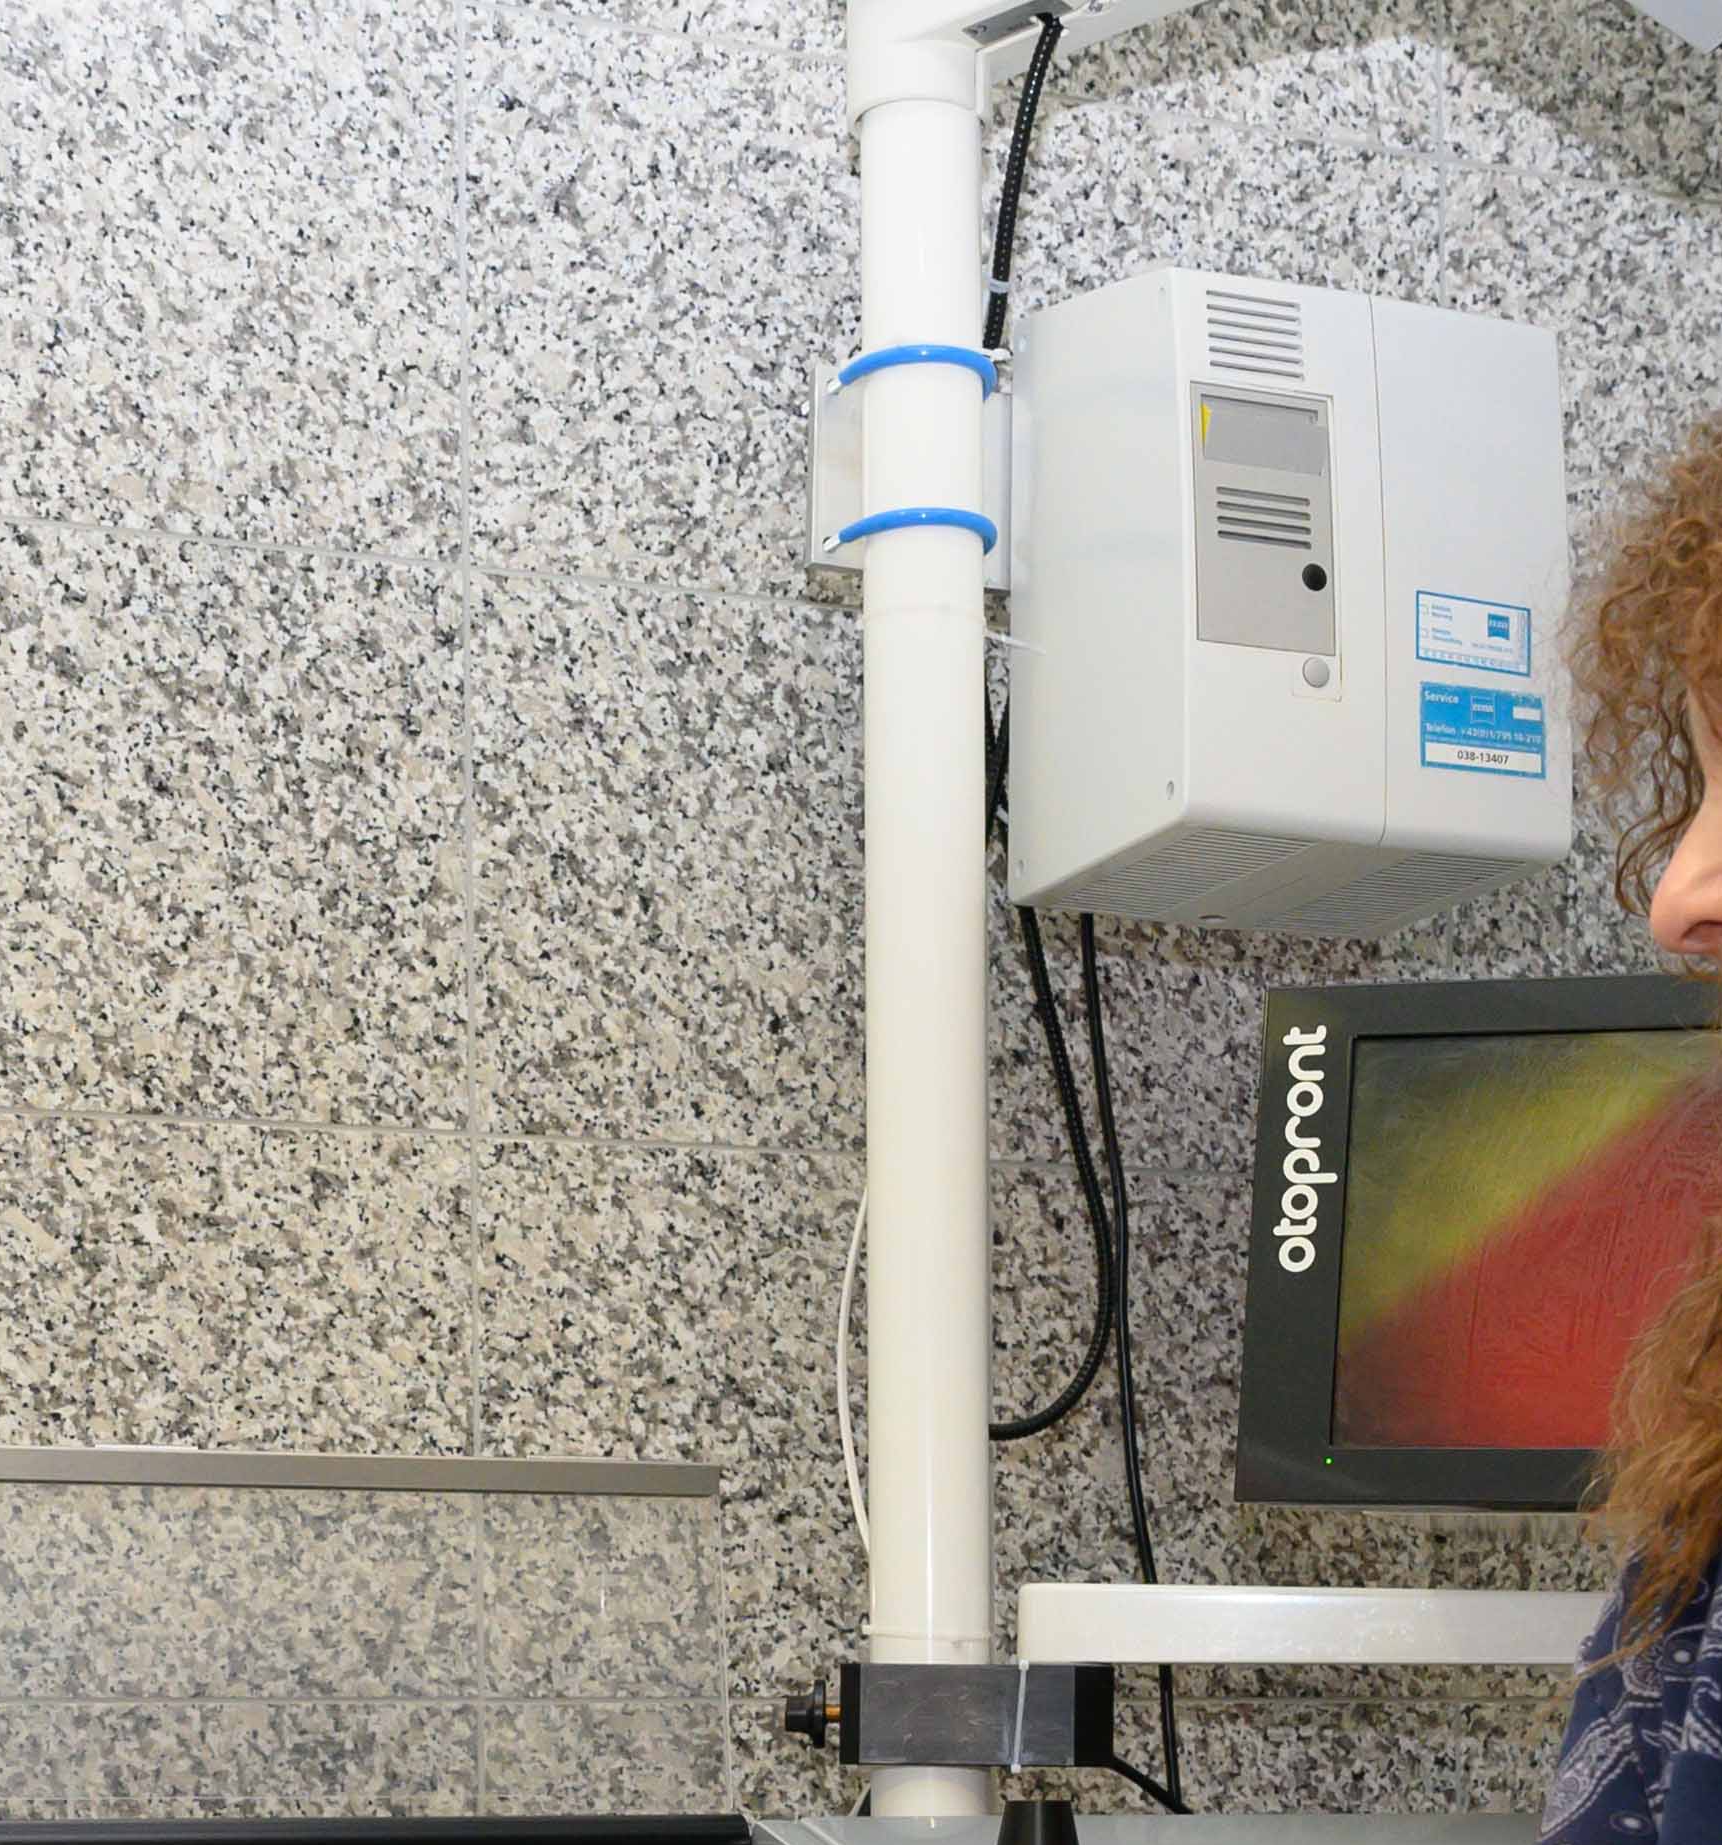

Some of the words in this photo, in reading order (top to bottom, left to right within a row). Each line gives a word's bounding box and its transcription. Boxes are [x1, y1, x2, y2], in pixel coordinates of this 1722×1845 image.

[1424, 691, 1459, 704] Service
[1425, 723, 1457, 735] Telefon
[1457, 749, 1509, 765] 038-13407
[1273, 1023, 1338, 1273] otopront
